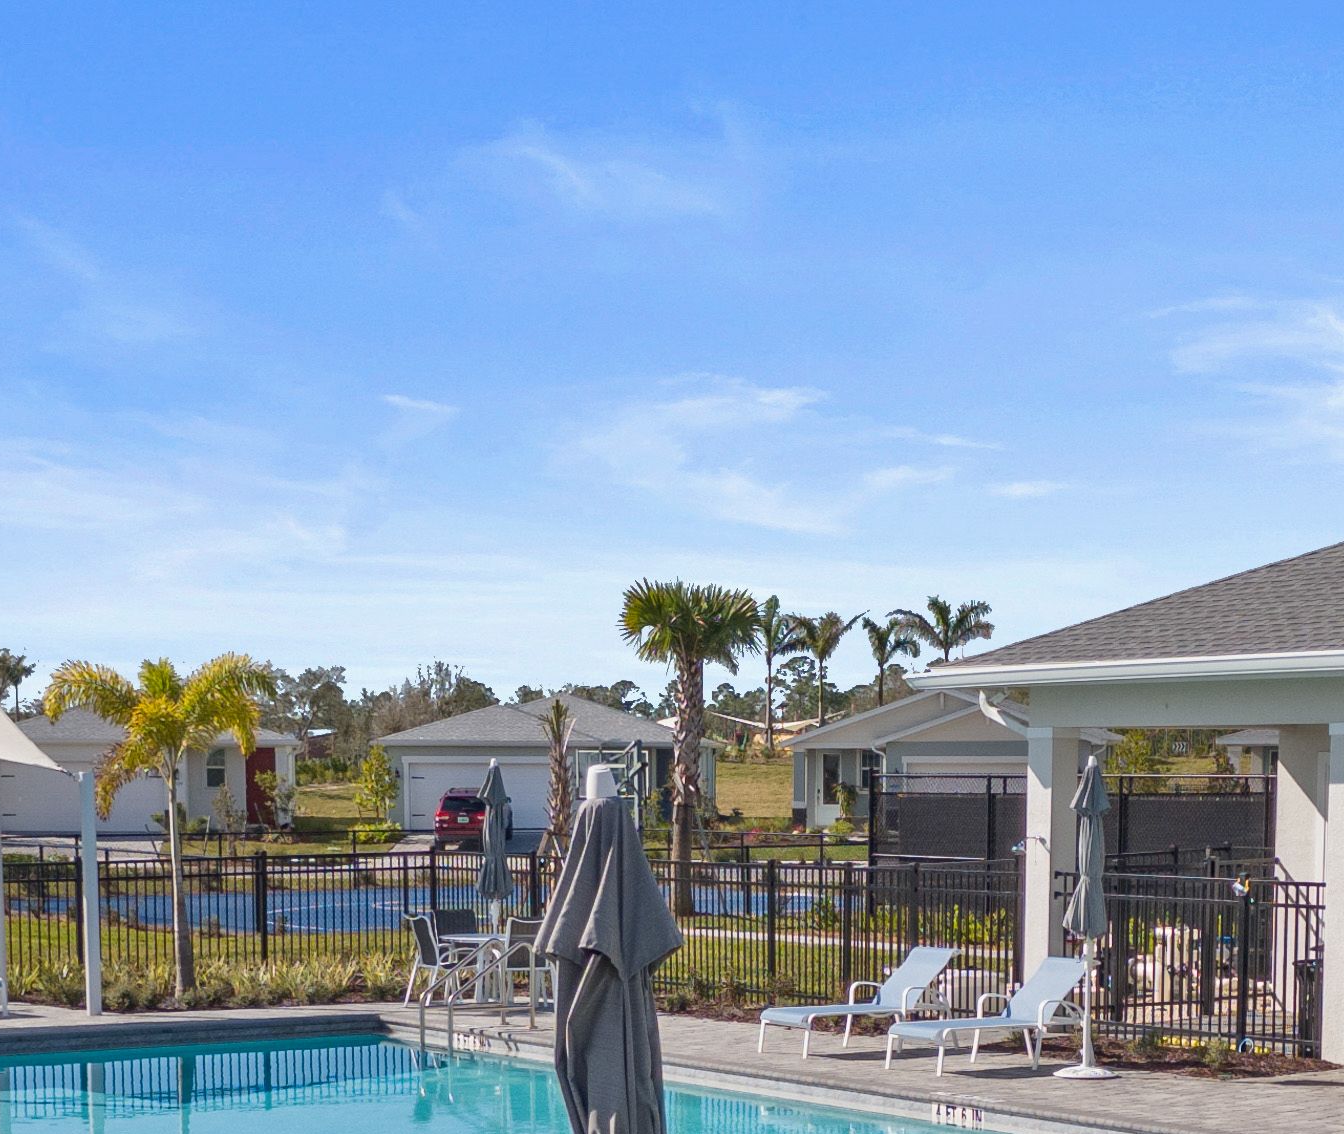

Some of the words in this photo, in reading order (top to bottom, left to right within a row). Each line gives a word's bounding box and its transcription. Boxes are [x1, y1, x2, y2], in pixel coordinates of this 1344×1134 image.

[945, 1104, 957, 1120] FT
[960, 1107, 967, 1122] 6
[971, 1108, 983, 1124] IN
